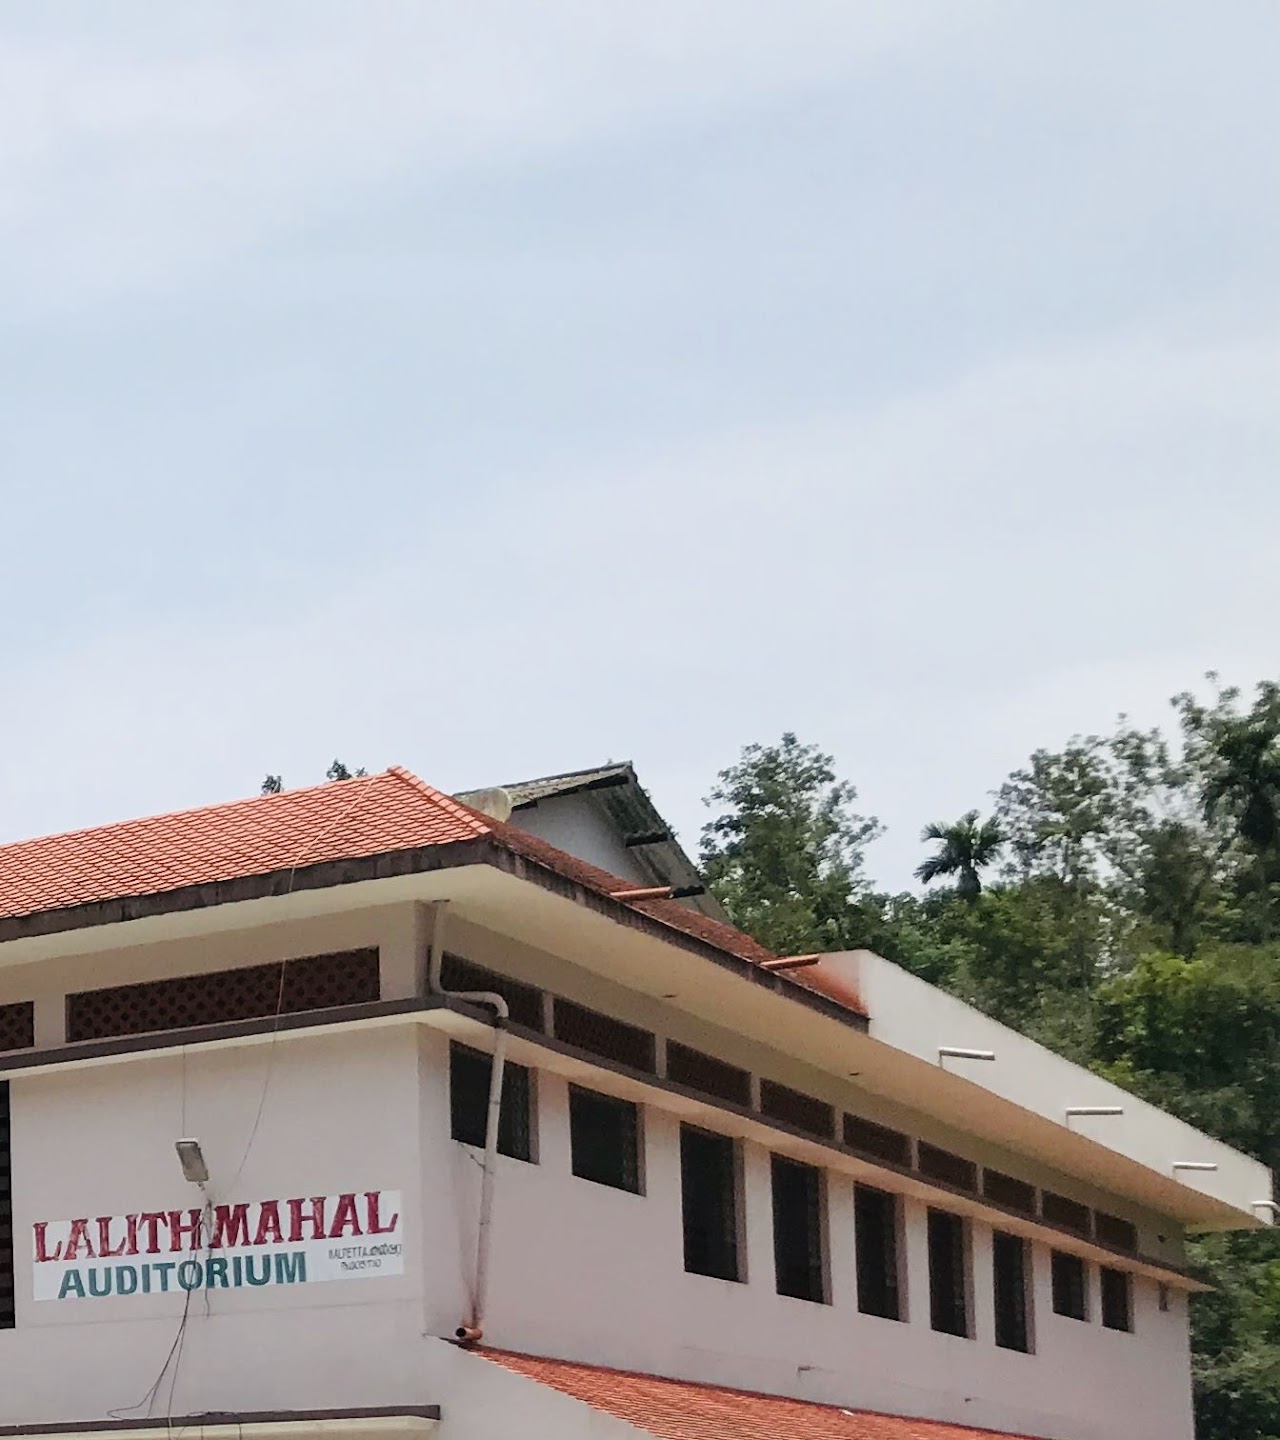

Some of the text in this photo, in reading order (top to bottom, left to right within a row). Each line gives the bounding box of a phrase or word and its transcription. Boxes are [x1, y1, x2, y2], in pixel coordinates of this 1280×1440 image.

[33, 1191, 399, 1263] LALITH MAHAL
[58, 1251, 307, 1299] AUDITORIUM
